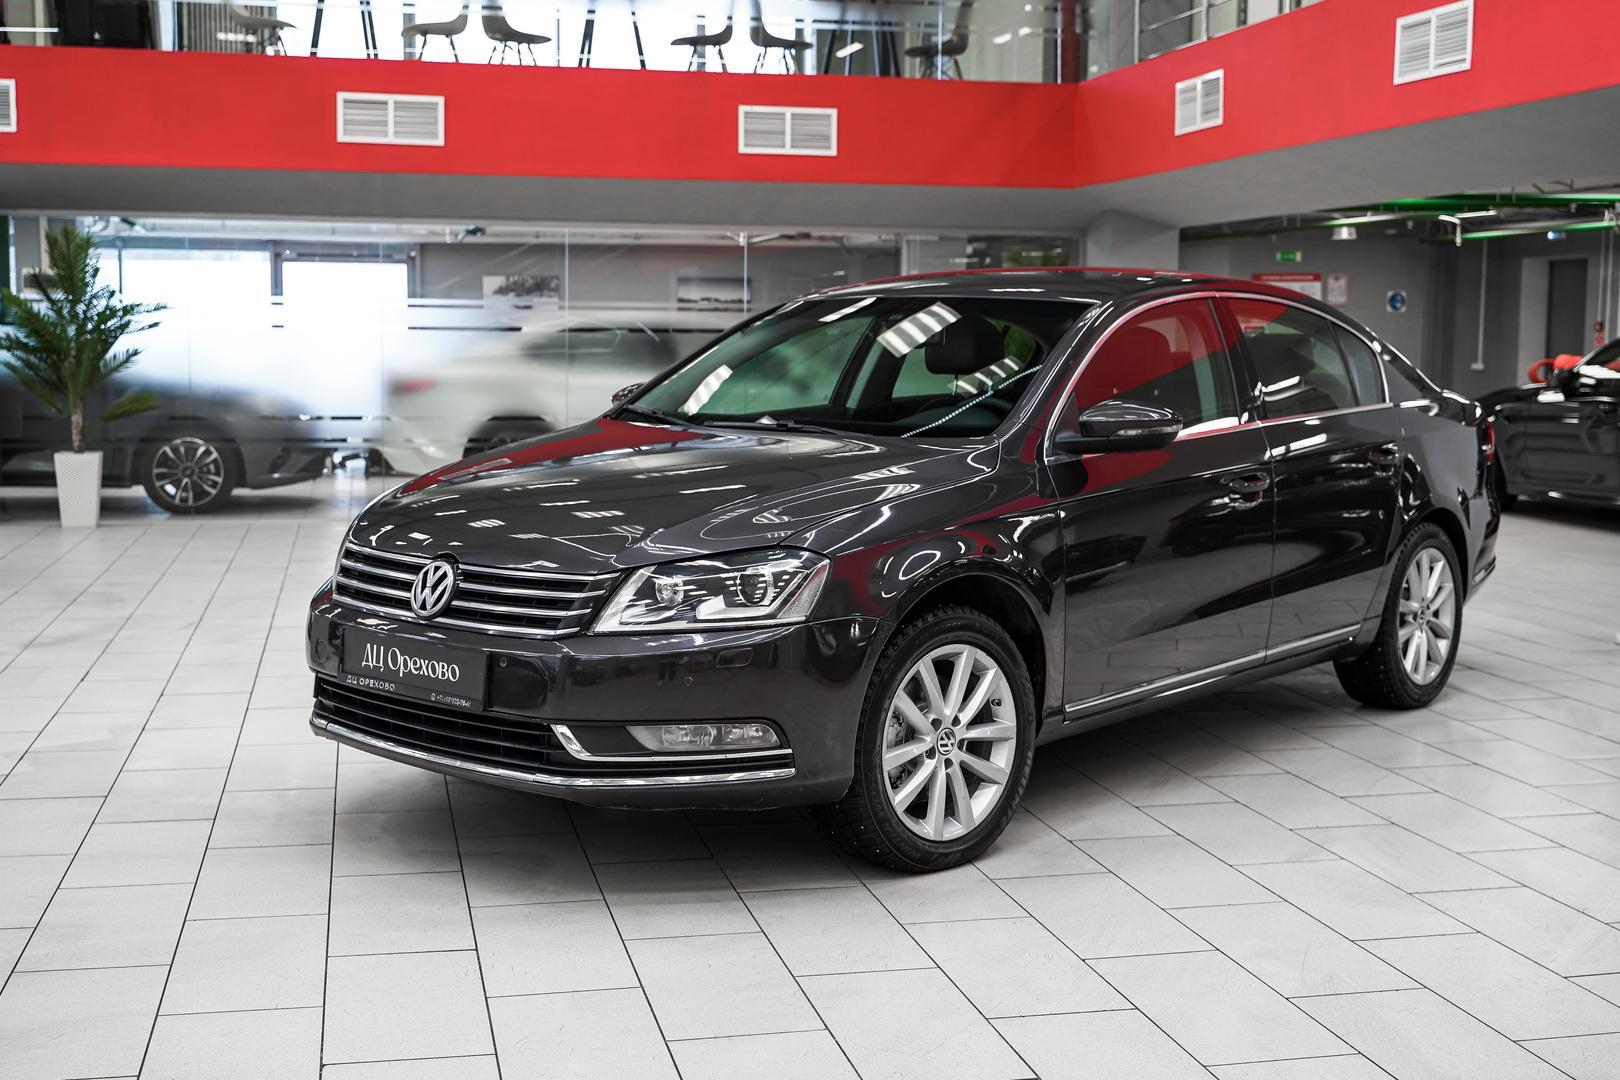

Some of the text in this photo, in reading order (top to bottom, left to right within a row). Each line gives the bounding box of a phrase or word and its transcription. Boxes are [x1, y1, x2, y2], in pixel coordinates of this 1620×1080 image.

[362, 643, 460, 681] ДЦ Орехово
[346, 675, 396, 691] ДЦ ОРЕХОВО
